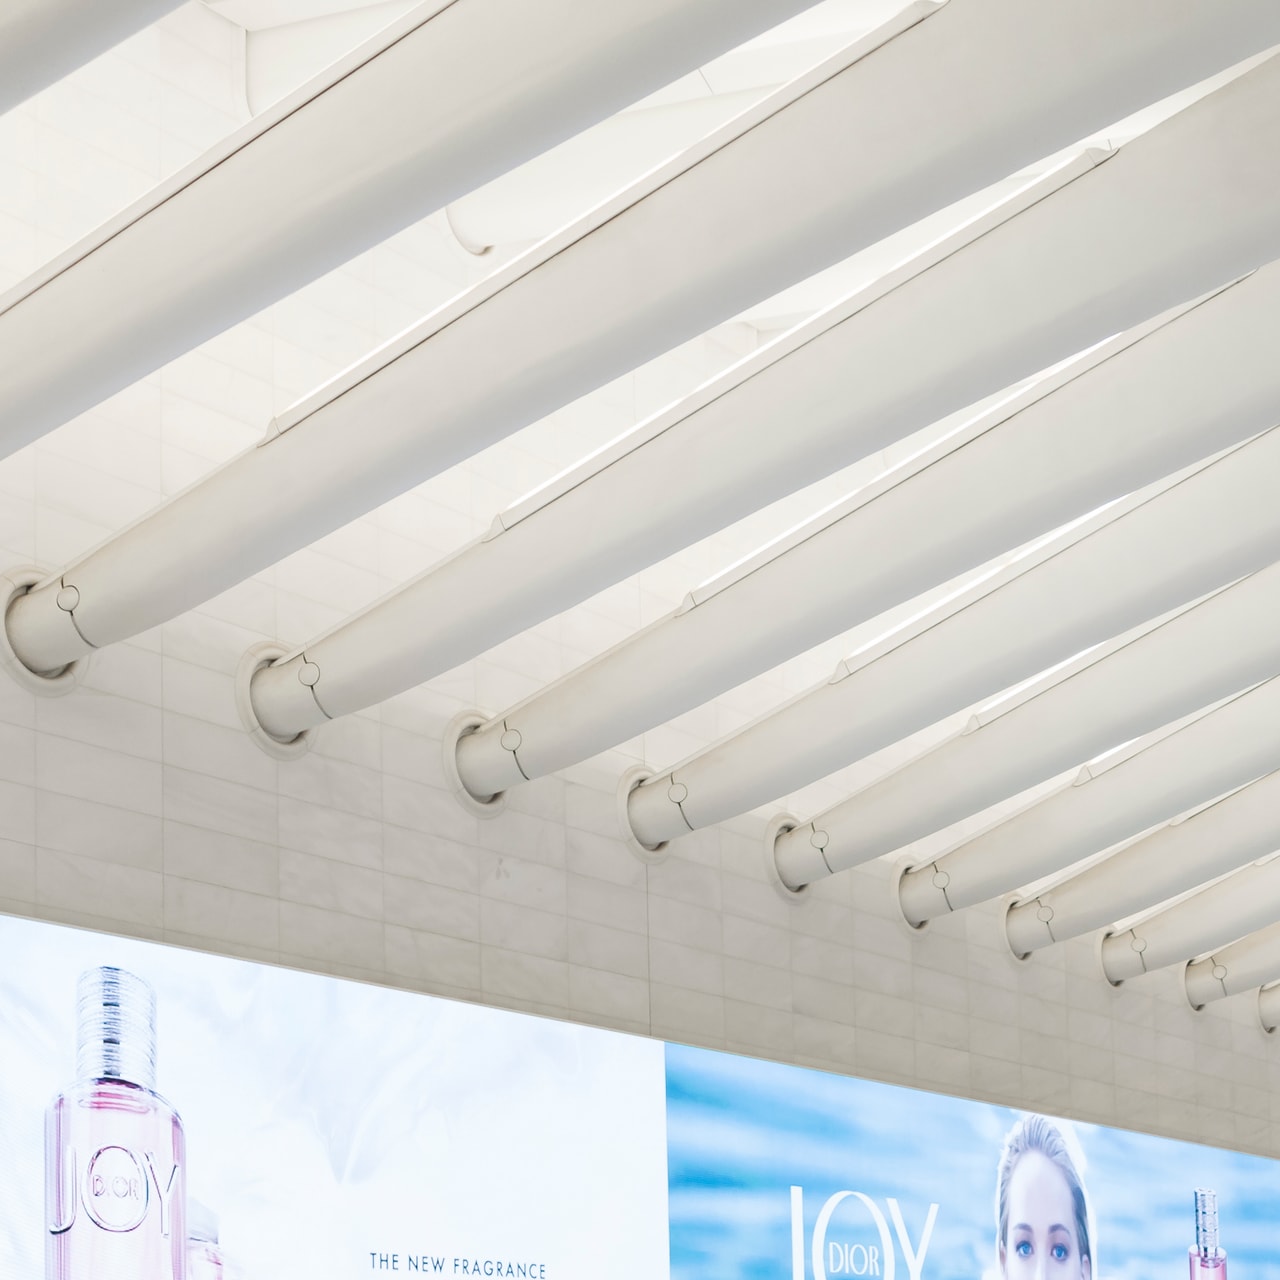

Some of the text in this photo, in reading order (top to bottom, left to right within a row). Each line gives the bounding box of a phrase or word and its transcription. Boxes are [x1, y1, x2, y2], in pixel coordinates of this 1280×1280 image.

[49, 1145, 179, 1239] JOY
[370, 1252, 546, 1280] THE NEW FRAGRANCE
[829, 1241, 880, 1276] DIOR
